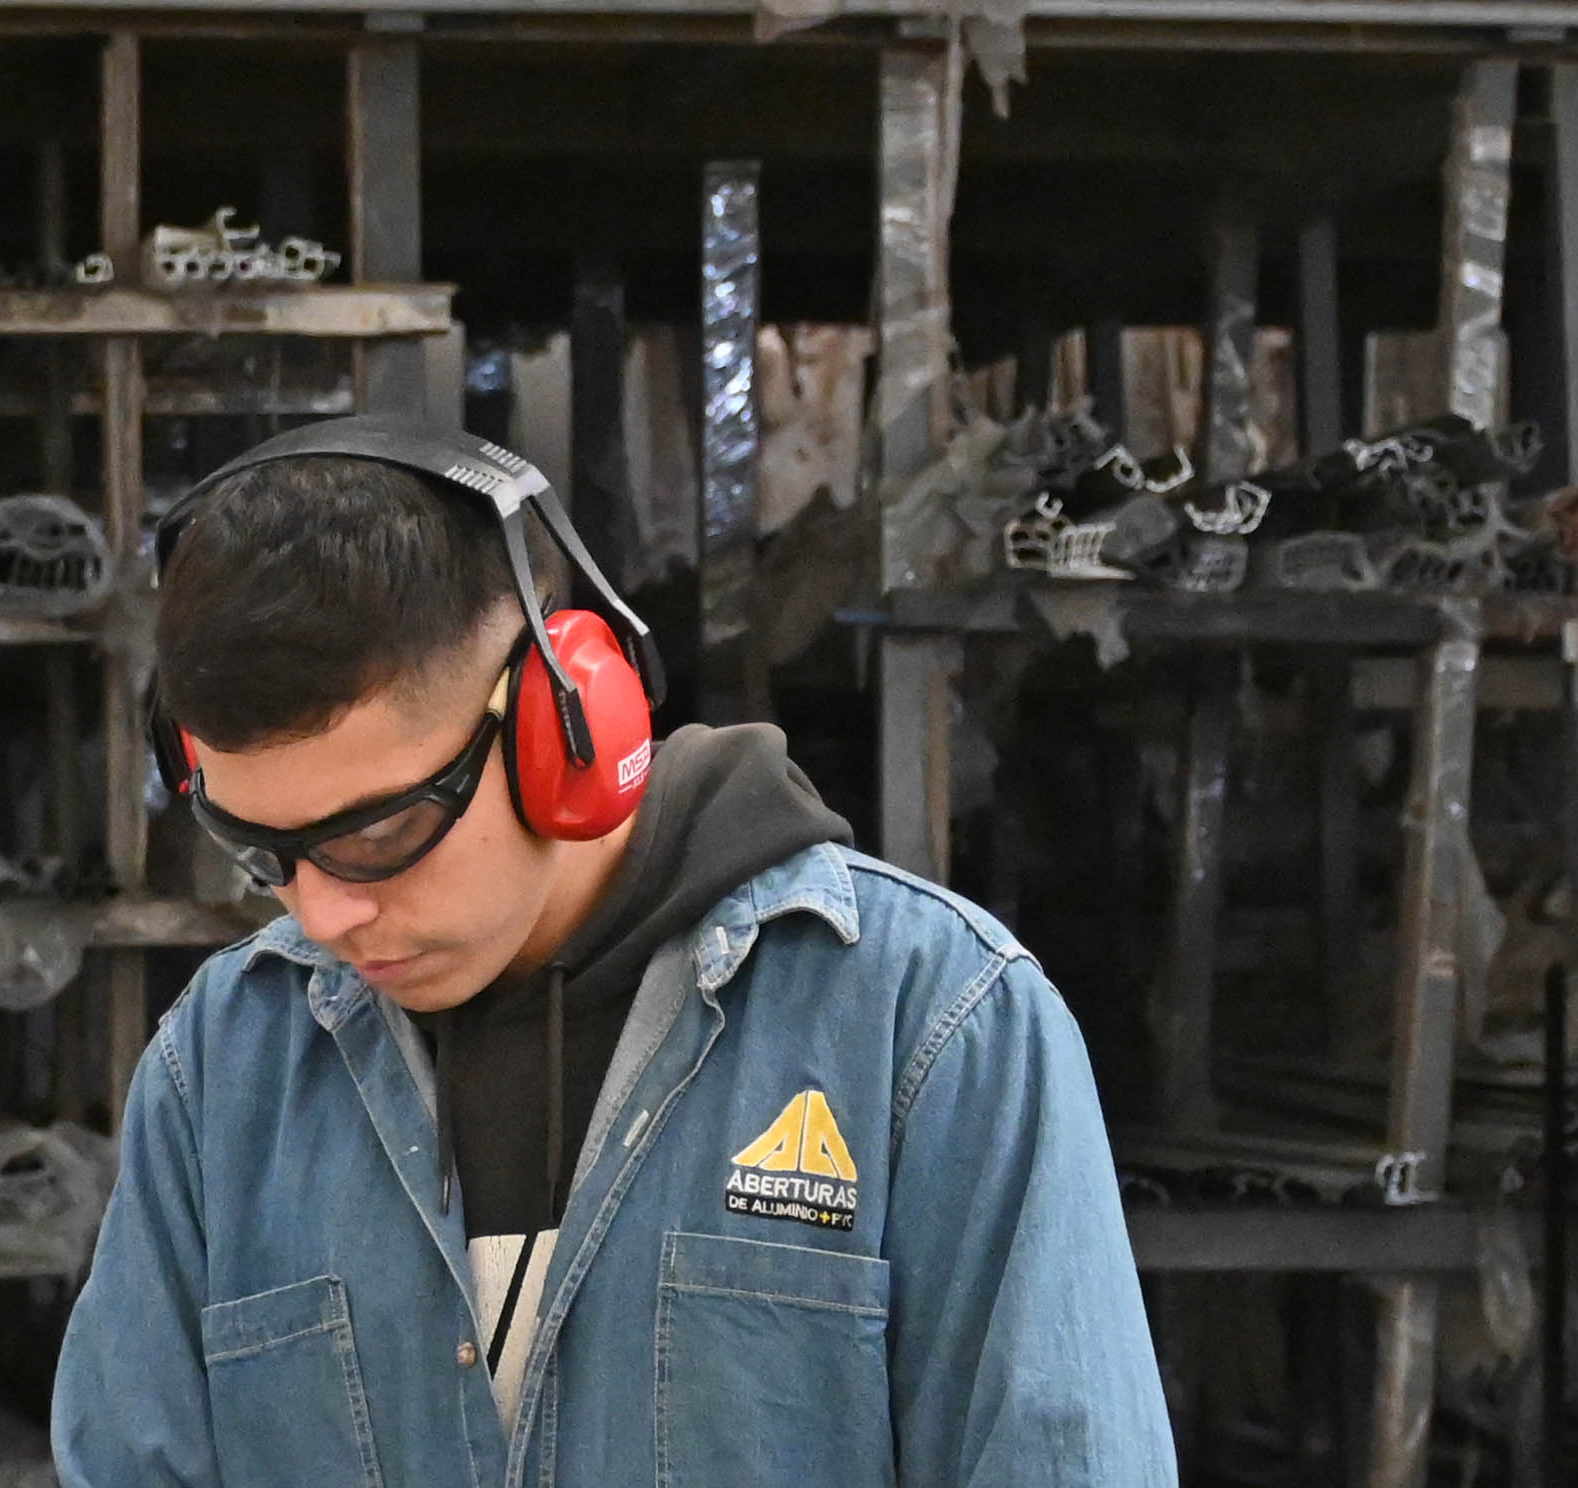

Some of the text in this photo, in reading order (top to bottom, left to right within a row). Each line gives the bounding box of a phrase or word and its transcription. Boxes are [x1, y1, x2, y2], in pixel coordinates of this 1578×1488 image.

[726, 1169, 858, 1209] ABERTURAS
[729, 1195, 748, 1209] DE
[751, 1199, 818, 1221] ALUMINIO
